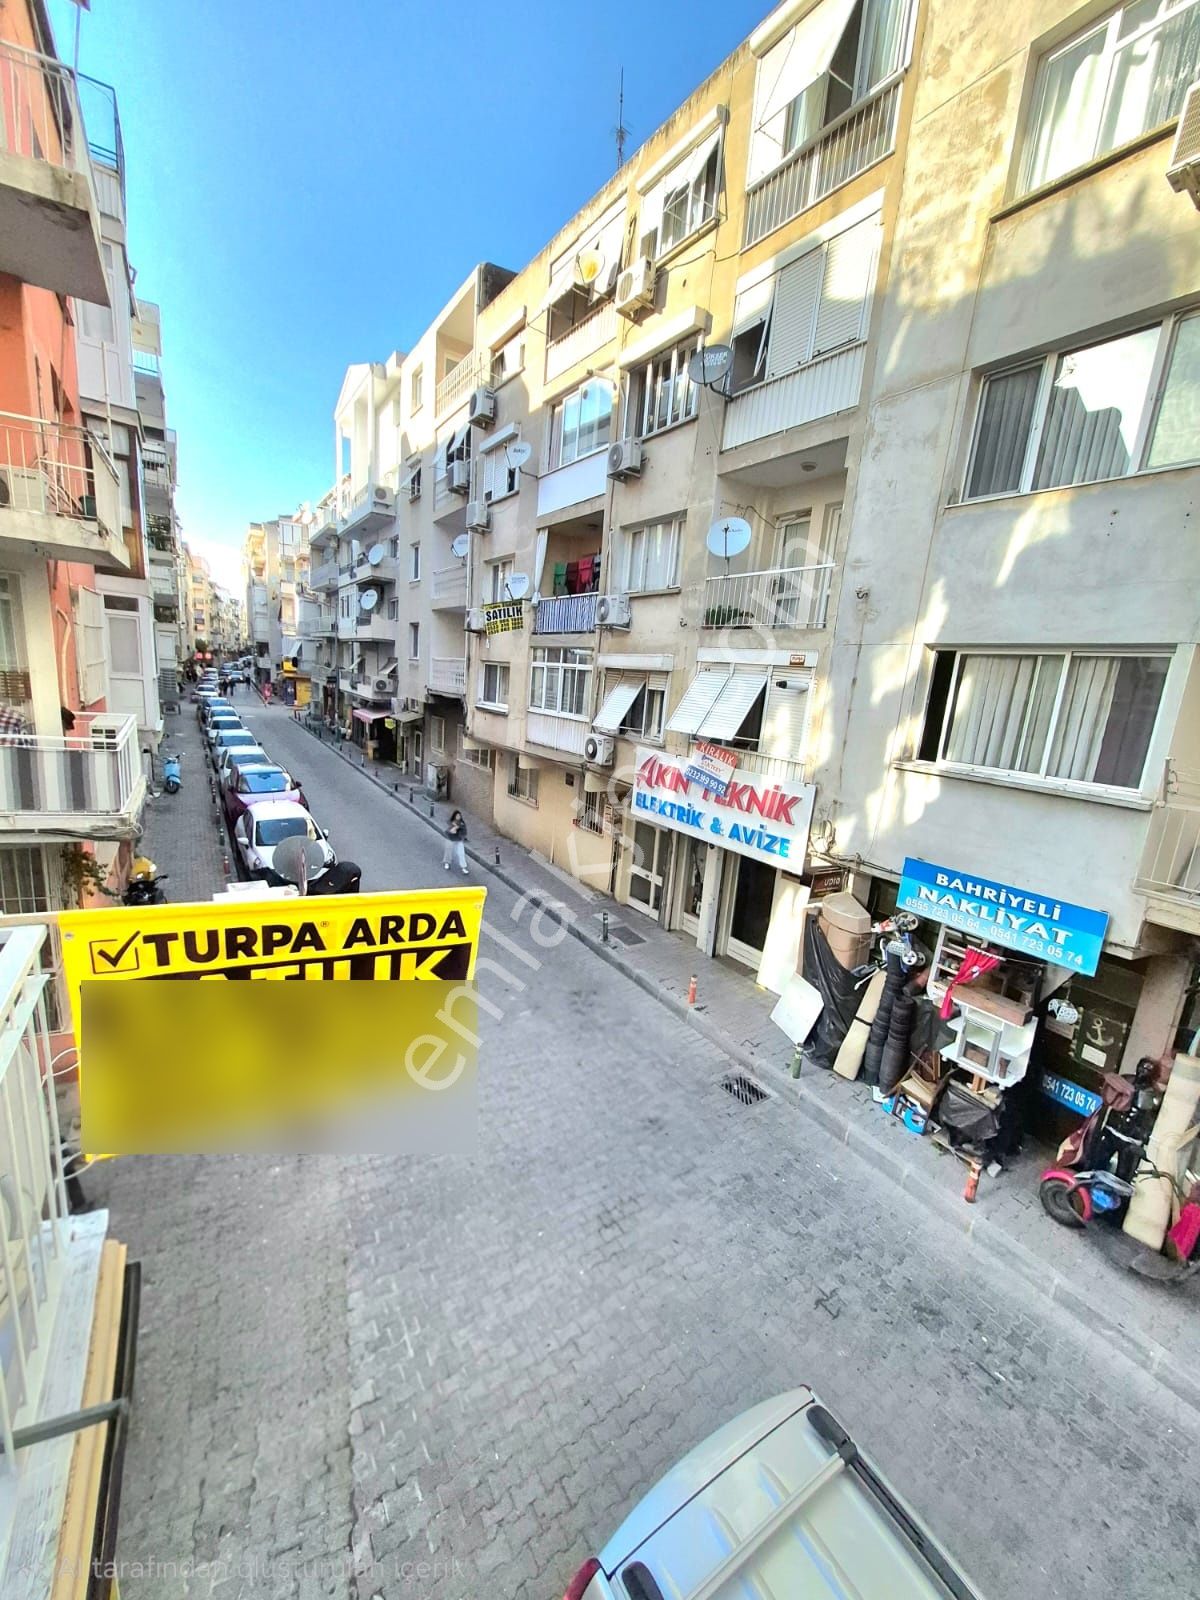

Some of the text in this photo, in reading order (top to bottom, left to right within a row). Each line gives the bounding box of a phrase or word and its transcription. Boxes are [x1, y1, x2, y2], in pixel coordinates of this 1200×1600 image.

[486, 606, 523, 622] SATILIK
[700, 742, 735, 766] KIRALIK
[636, 753, 690, 795] AKIN
[701, 780, 803, 826] EKNİK
[635, 791, 705, 830] ELEKTRİK
[710, 816, 724, 836] &
[728, 823, 791, 858] AVİZE
[919, 885, 1073, 946] NAKLİYAT
[936, 872, 1061, 921] BAHRİYELİ
[343, 910, 467, 949] ARDA
[951, 909, 965, 925] 05
[990, 924, 1017, 946] 0541
[1022, 935, 1044, 952] 723
[1047, 944, 1064, 960] 05
[1066, 951, 1084, 967] 74
[1060, 1083, 1075, 1102] 723
[1074, 1091, 1086, 1108] 05
[1085, 1096, 1097, 1113] 74
